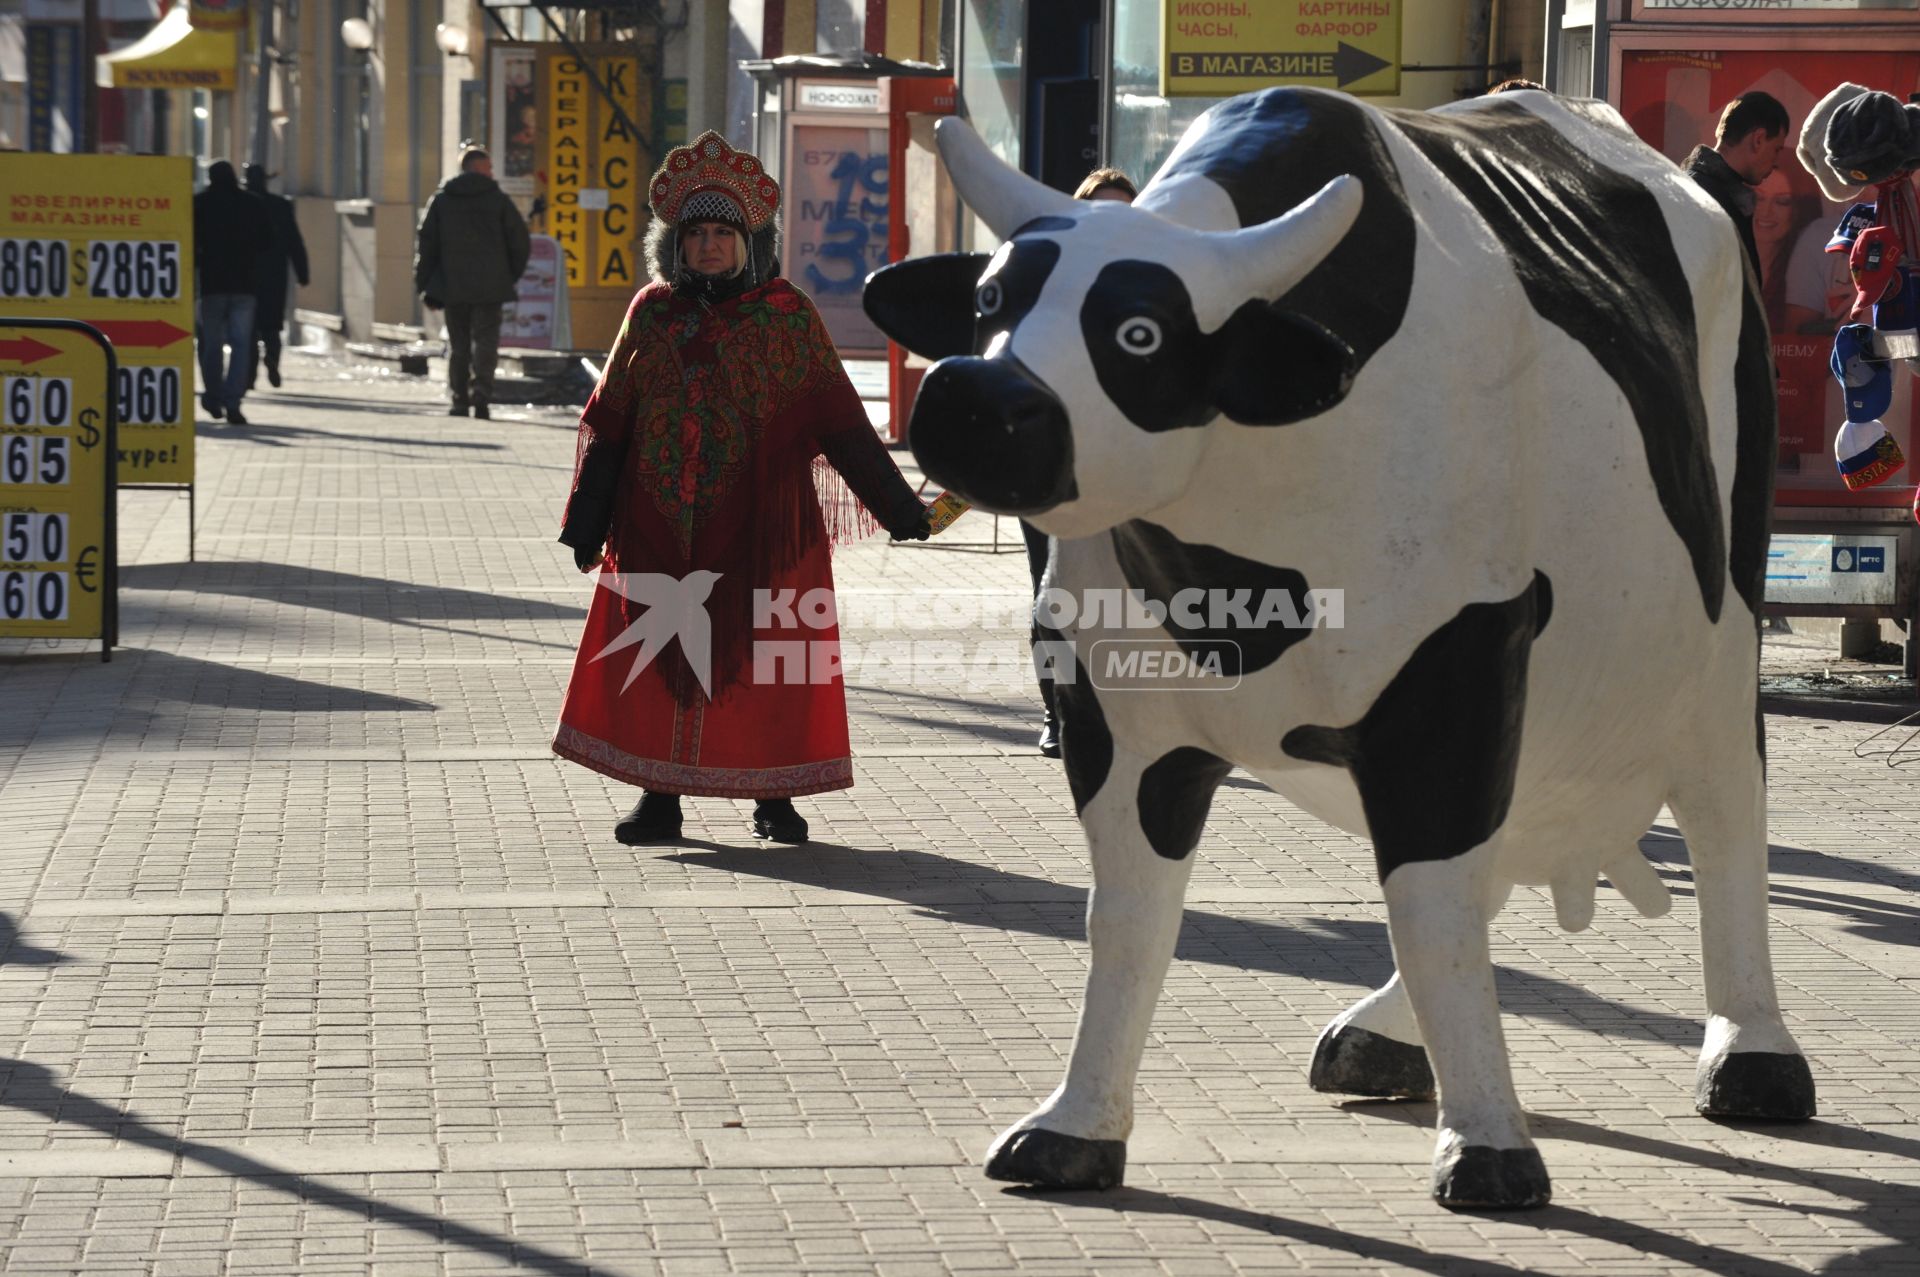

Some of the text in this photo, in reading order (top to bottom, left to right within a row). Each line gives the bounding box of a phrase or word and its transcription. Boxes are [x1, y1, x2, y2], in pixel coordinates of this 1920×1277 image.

[1177, 1, 1390, 19] ИКОНЫ, КАРТИНЫ
[1177, 22, 1378, 38] ЧАСЫ, ФАРФОР
[1178, 56, 1334, 74] В МАГАЗИНЕ
[603, 62, 630, 281] КАССА
[9, 194, 171, 210] ЮВЕЛИРНОМ
[9, 210, 142, 226] МАГАЗИНЕ
[91, 242, 178, 298] 2865
[1773, 343, 1817, 357] НЕМУ
[11, 378, 67, 426] 60
[8, 436, 65, 484] 65
[8, 514, 62, 562] 50
[4, 571, 63, 619] 60
